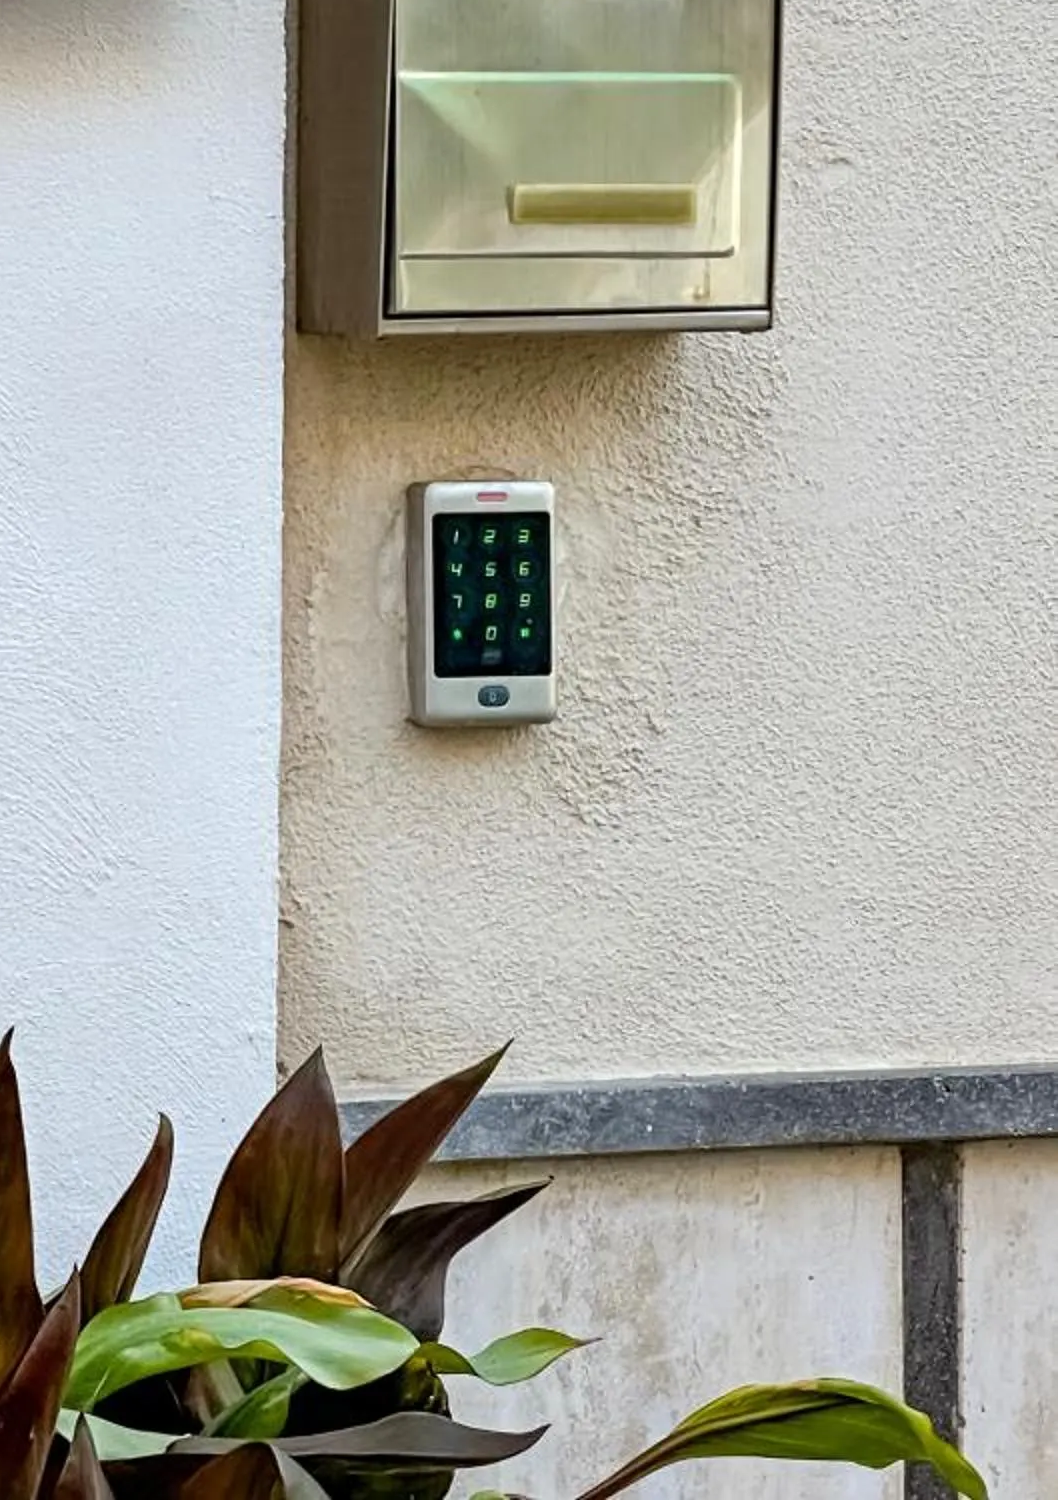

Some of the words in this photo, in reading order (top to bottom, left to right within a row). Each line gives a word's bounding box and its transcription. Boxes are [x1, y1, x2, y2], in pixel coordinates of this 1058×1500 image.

[483, 529, 497, 543] 2
[518, 529, 530, 543] 3
[451, 563, 463, 577] 4
[485, 561, 497, 577] 5
[519, 561, 530, 576] 6
[451, 594, 463, 609] 7
[485, 593, 497, 609] 8
[519, 593, 531, 608] 9
[485, 626, 498, 641] 0
